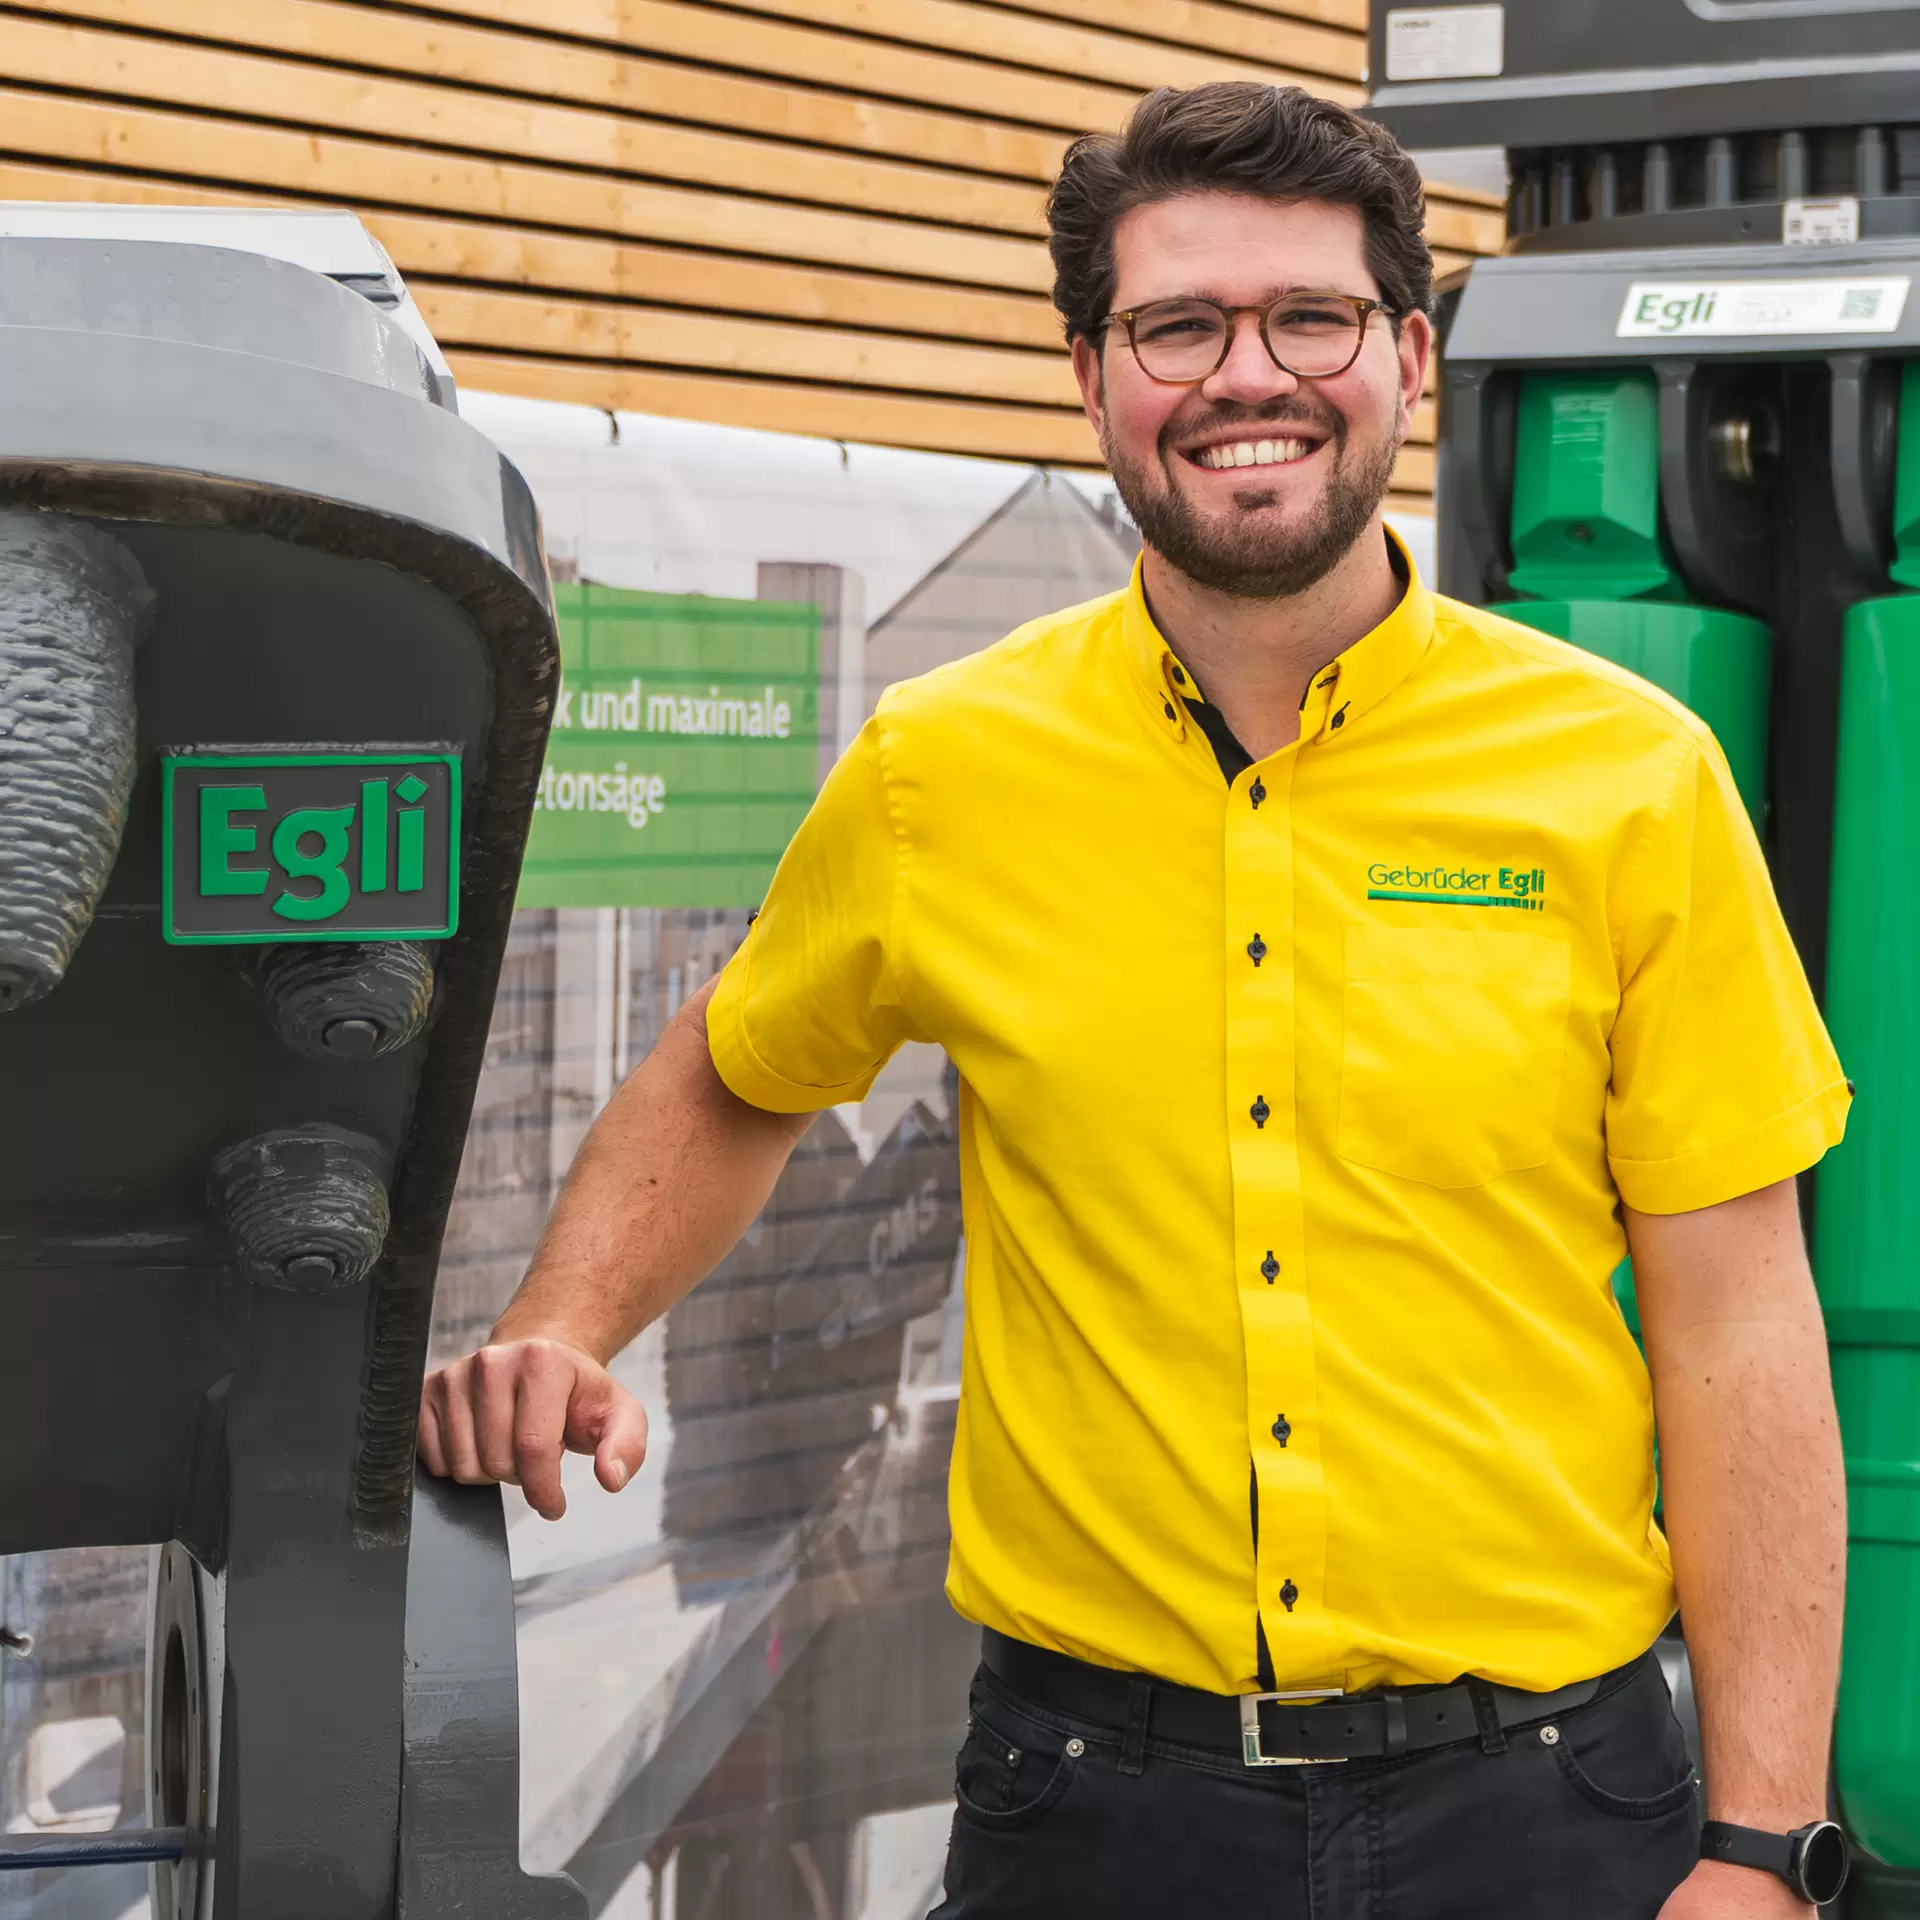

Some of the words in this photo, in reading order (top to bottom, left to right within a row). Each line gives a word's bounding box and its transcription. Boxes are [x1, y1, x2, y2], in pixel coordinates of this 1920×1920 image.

[1634, 291, 1718, 332] Egli
[580, 677, 641, 731] und
[647, 685, 791, 738] maximale
[199, 772, 429, 921] Egli
[1368, 863, 1491, 891] Gebrüder
[1499, 867, 1546, 897] Egli
